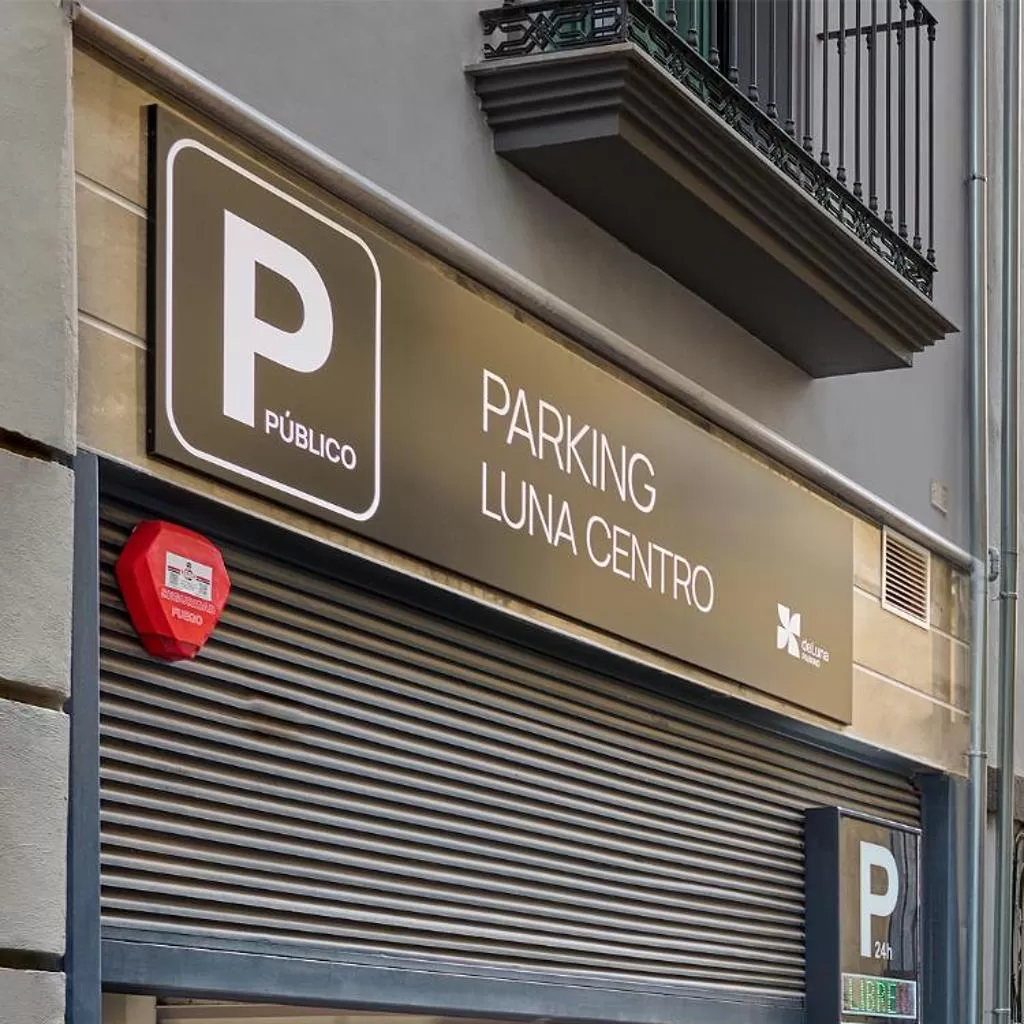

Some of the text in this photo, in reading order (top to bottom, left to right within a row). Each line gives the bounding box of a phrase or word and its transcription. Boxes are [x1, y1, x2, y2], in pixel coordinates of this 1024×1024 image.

[223, 209, 333, 427] P
[265, 410, 358, 471] PÚBLICO
[482, 369, 656, 513] PARKING
[482, 461, 714, 613] LUNA CENTRO
[860, 840, 899, 958] P
[874, 941, 893, 960] 24h
[848, 978, 897, 1014] LIBRE
